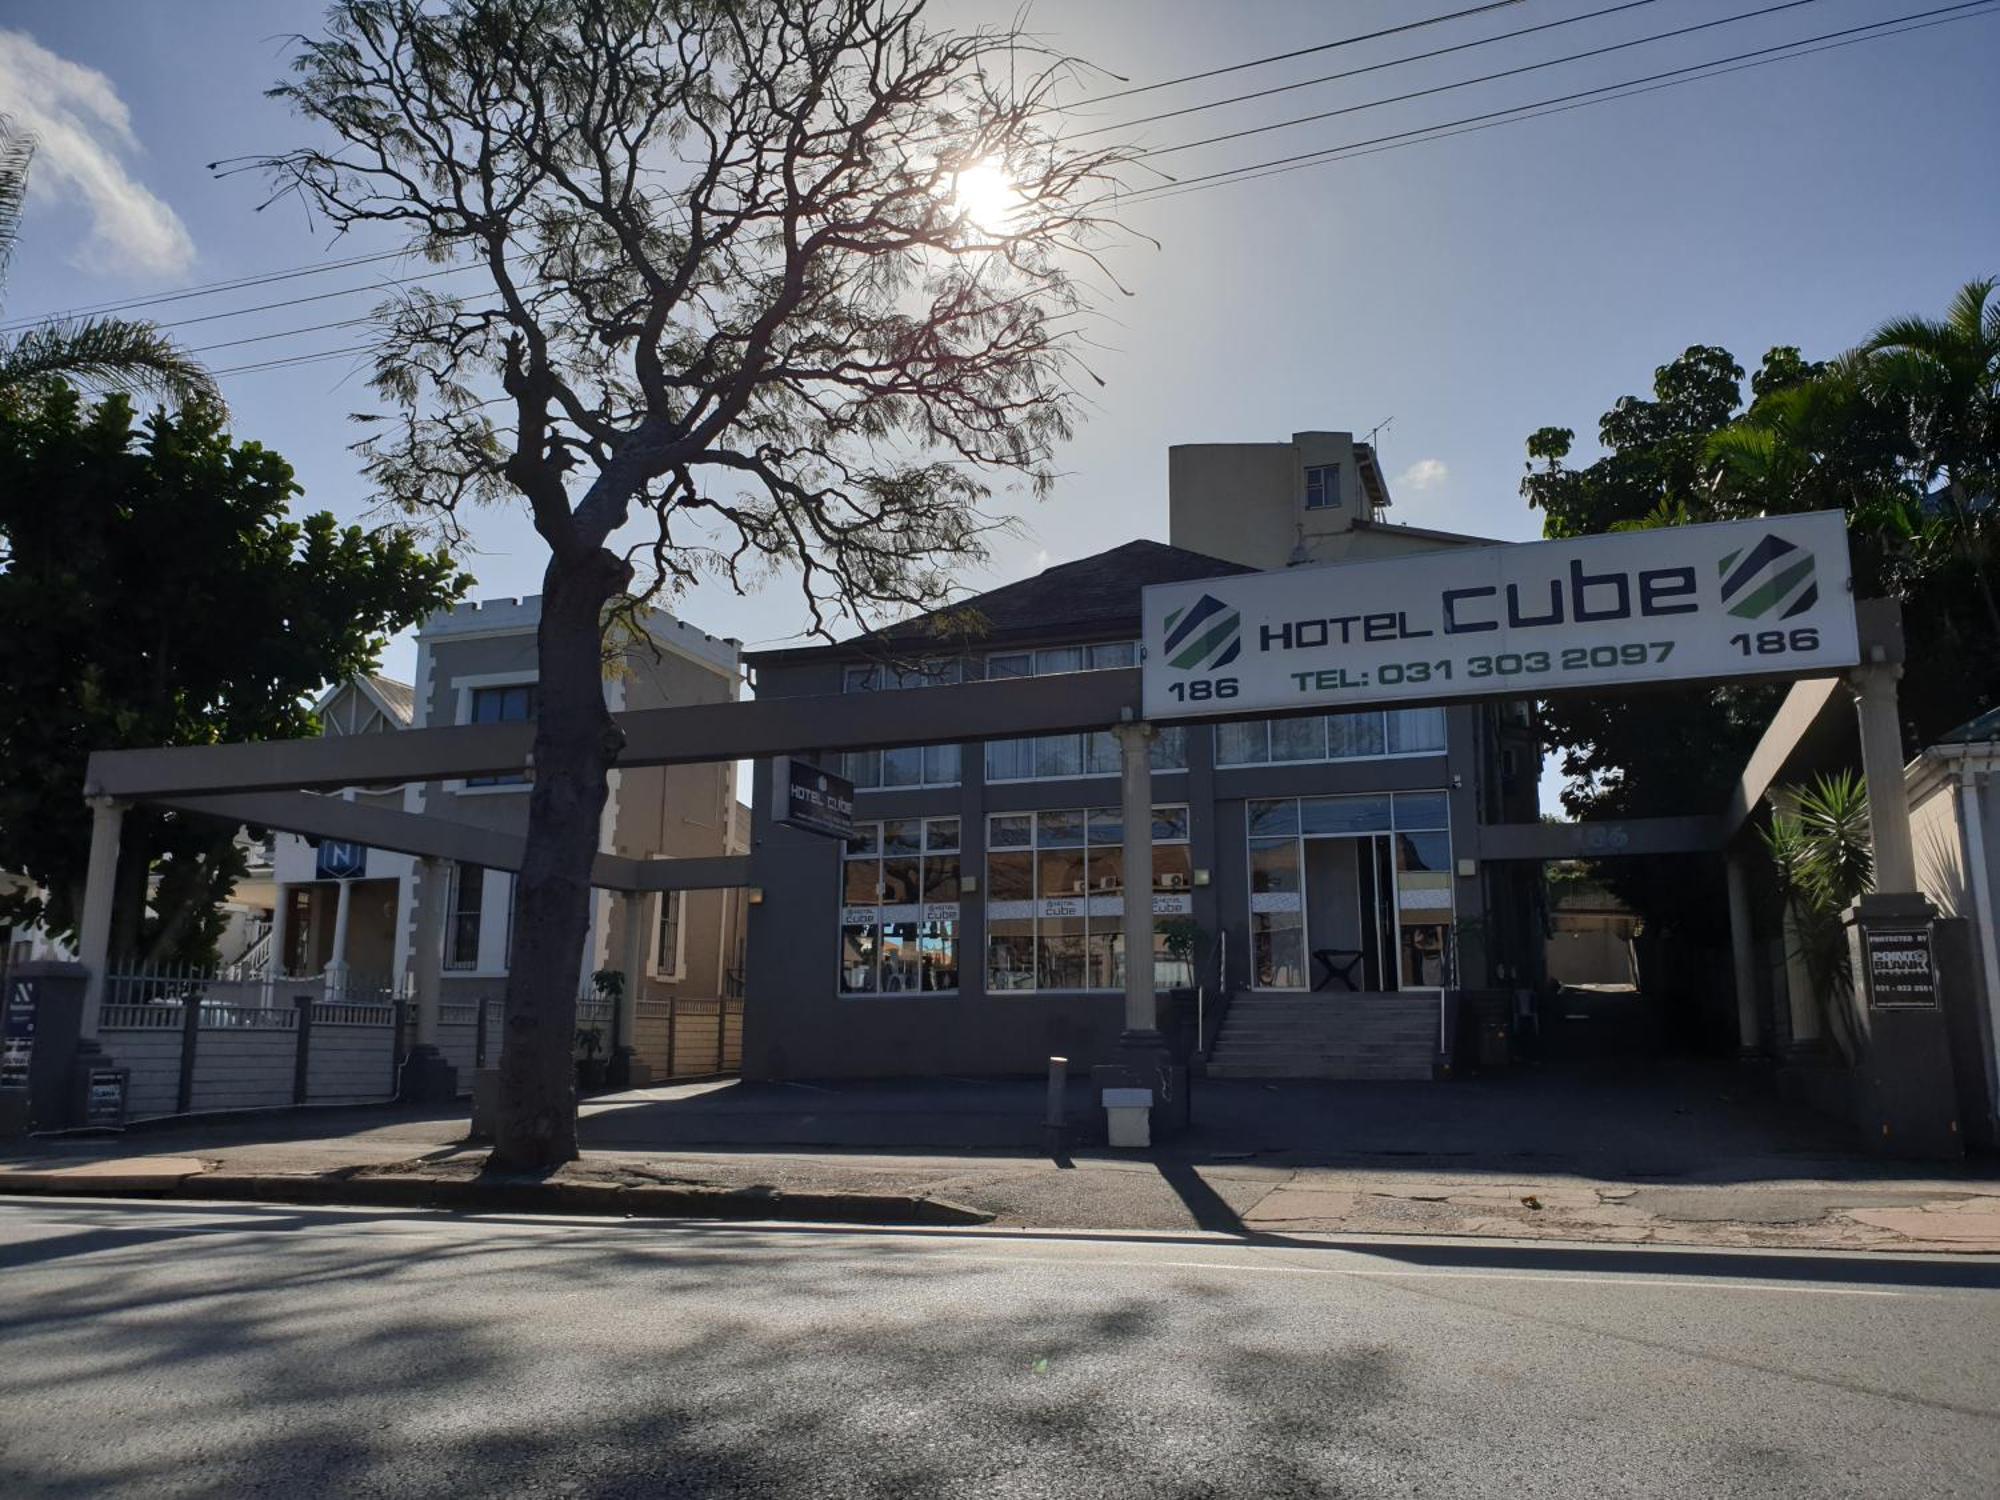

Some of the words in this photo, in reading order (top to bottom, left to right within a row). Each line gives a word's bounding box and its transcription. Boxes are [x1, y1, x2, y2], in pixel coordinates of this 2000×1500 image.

[1730, 628, 1819, 656] 186
[1291, 669, 1369, 691] TEL:
[1377, 659, 1453, 685] 031
[1467, 651, 1551, 679] 303
[1561, 641, 1675, 670] 2097
[1168, 677, 1239, 702] 186
